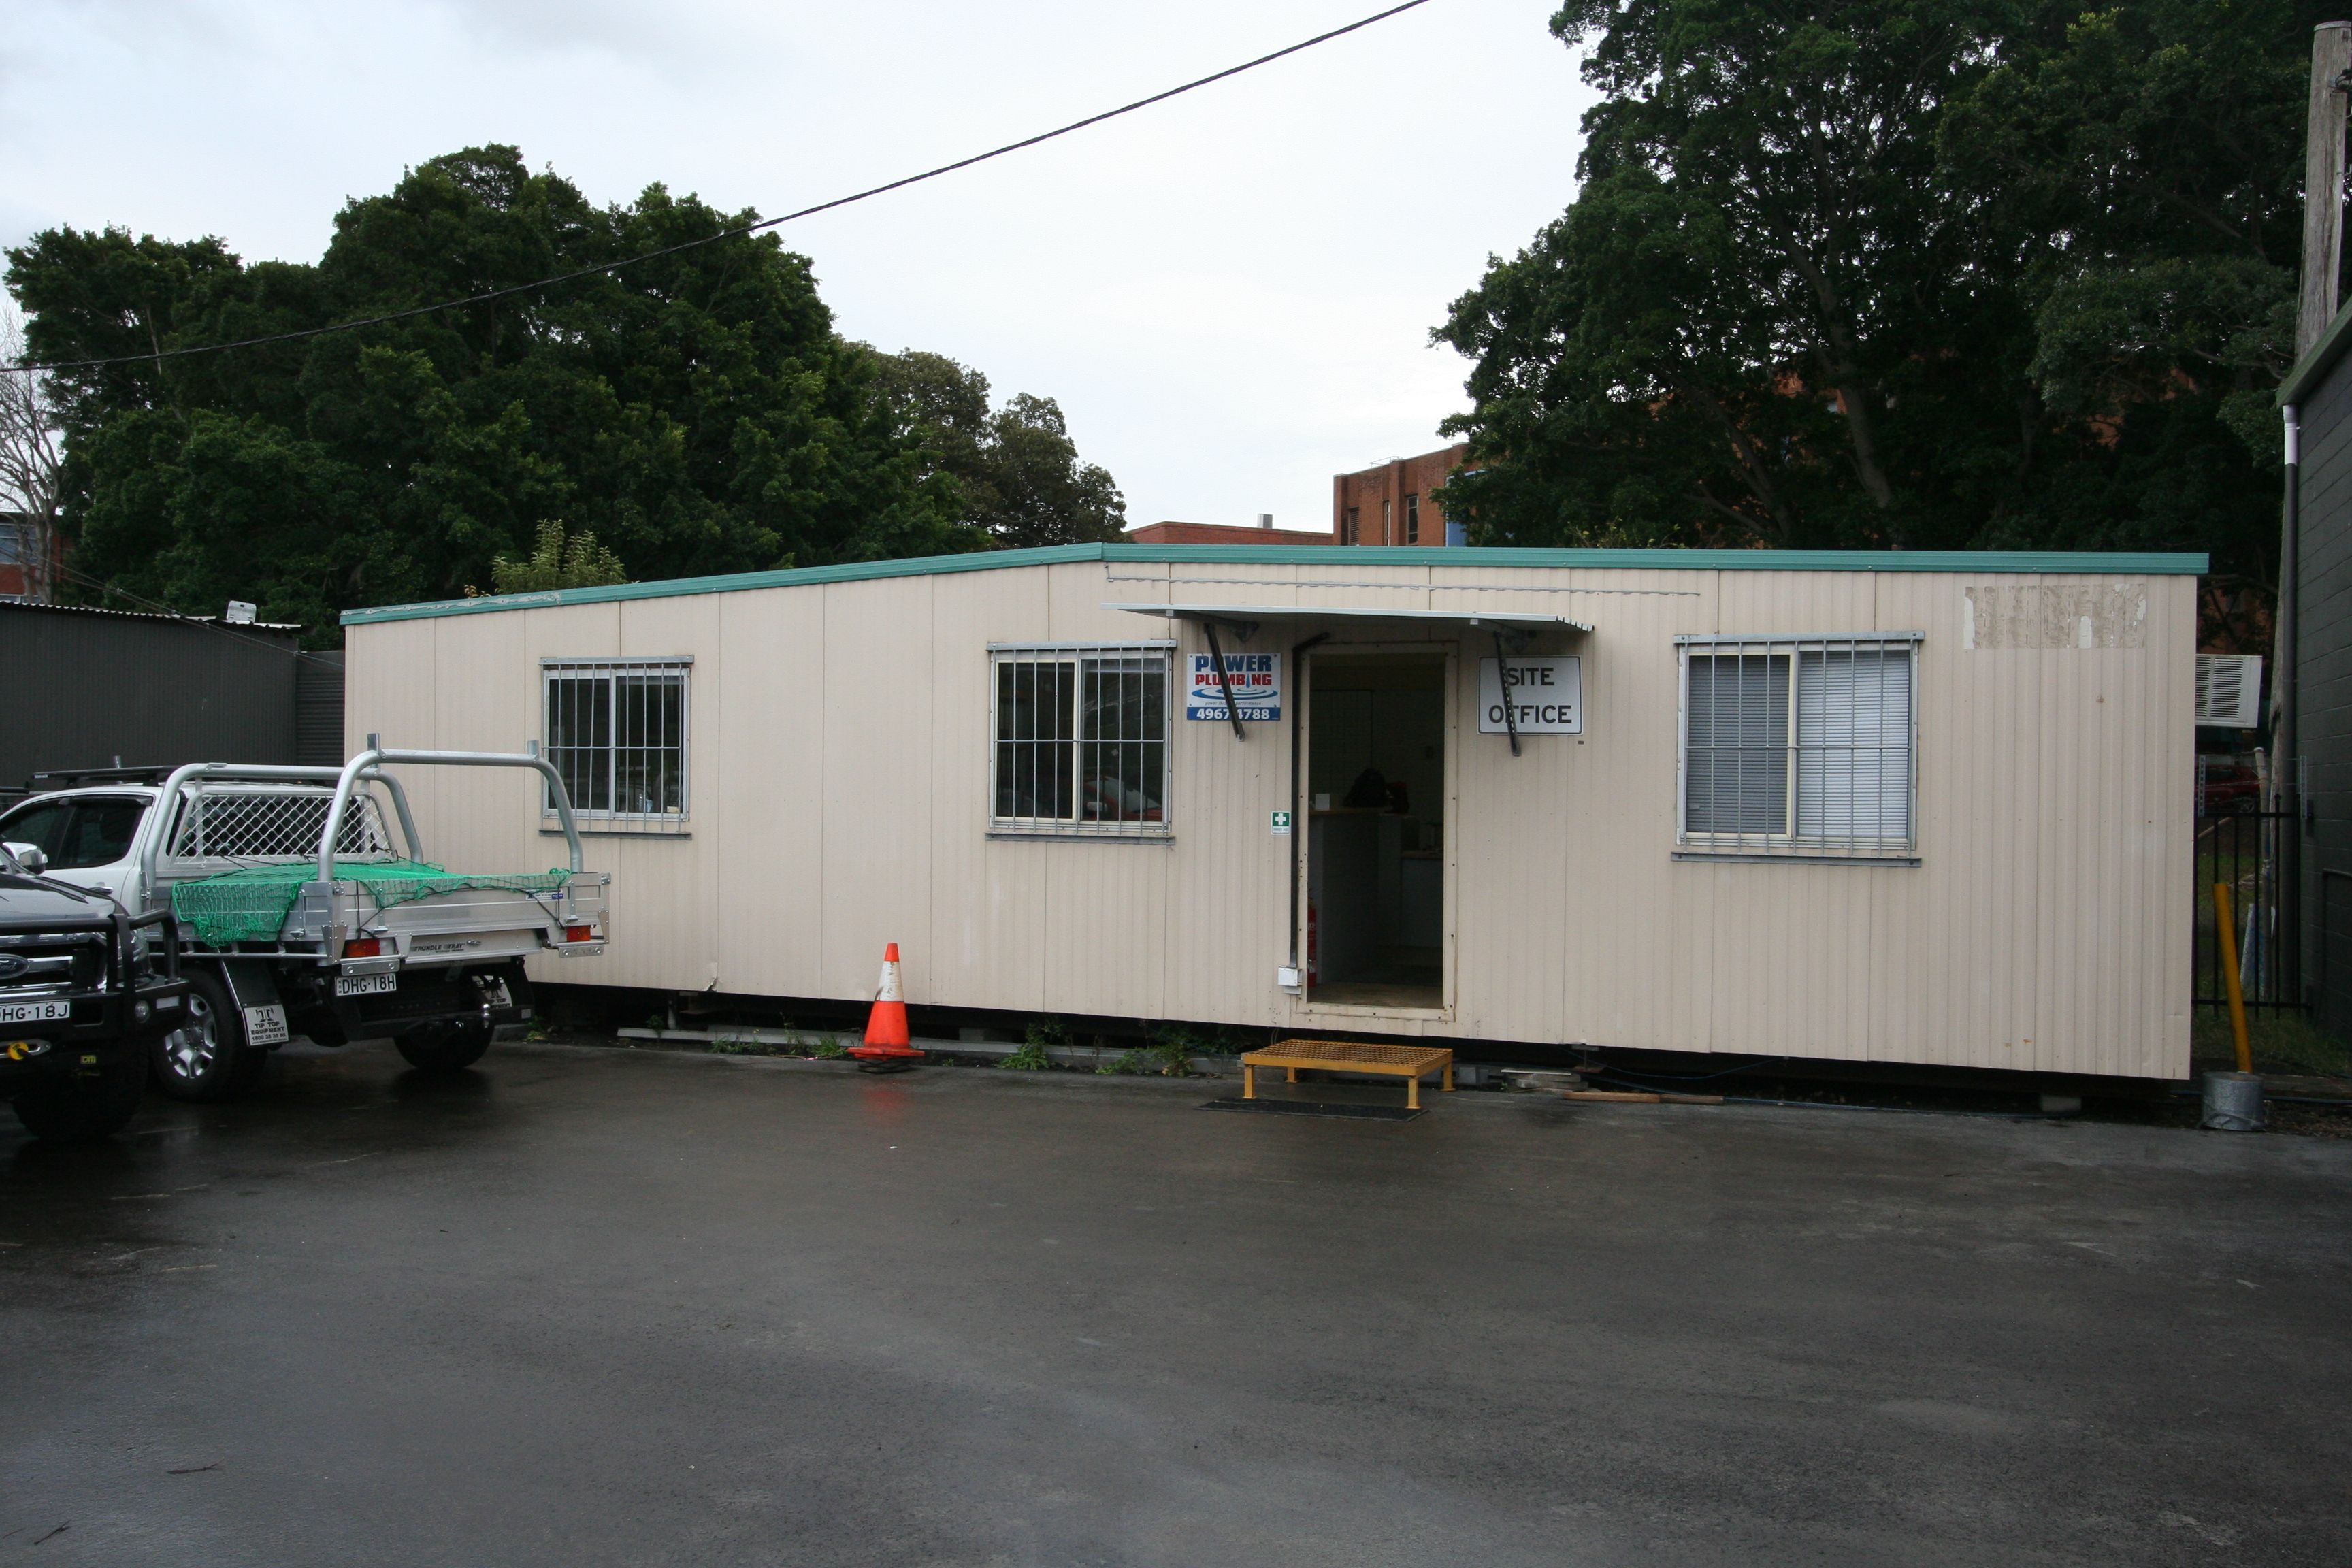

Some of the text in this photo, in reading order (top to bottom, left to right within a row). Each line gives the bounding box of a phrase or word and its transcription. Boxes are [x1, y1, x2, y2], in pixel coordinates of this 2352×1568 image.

[1507, 667, 1554, 686] SITE
[1196, 708, 1229, 719] 4967
[0, 1004, 67, 1021] HG·18J
